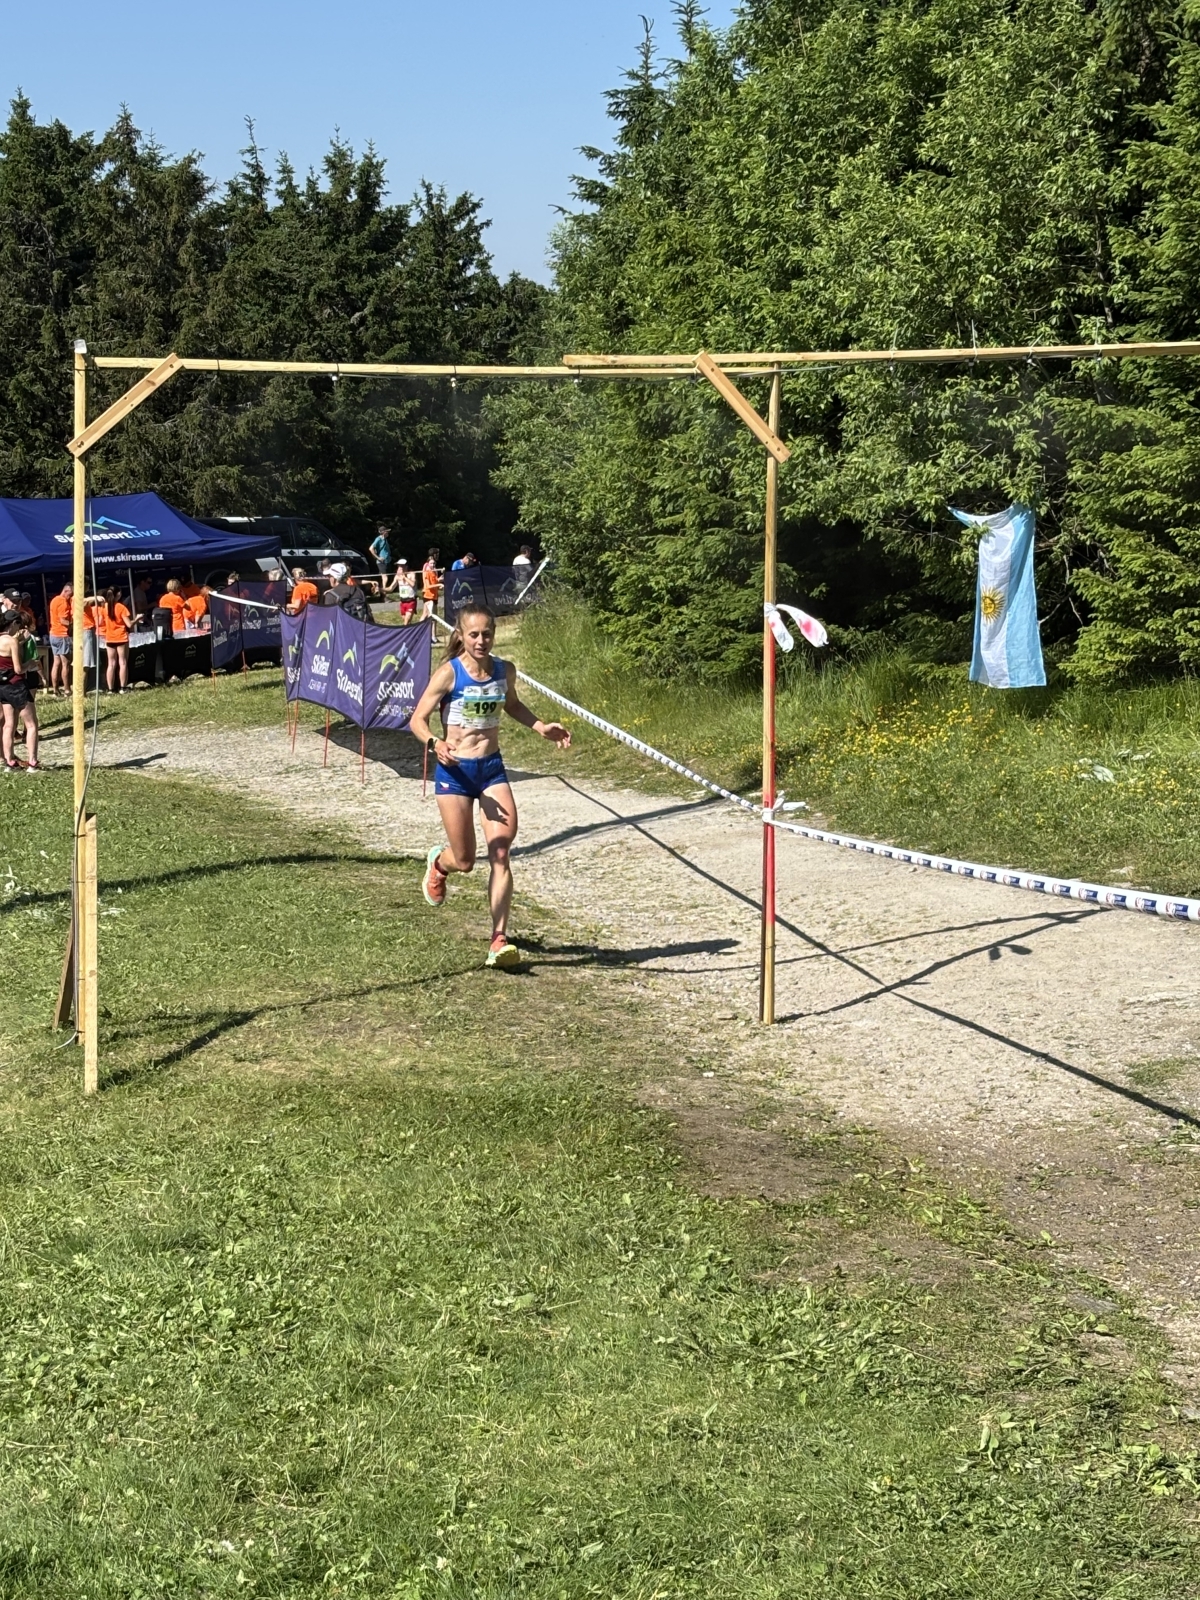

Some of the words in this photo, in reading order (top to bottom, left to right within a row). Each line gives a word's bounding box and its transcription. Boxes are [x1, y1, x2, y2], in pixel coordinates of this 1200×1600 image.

[54, 529, 161, 543] SkResortLive
[94, 553, 164, 564] www.skiresort.cz
[474, 701, 497, 715] 199
